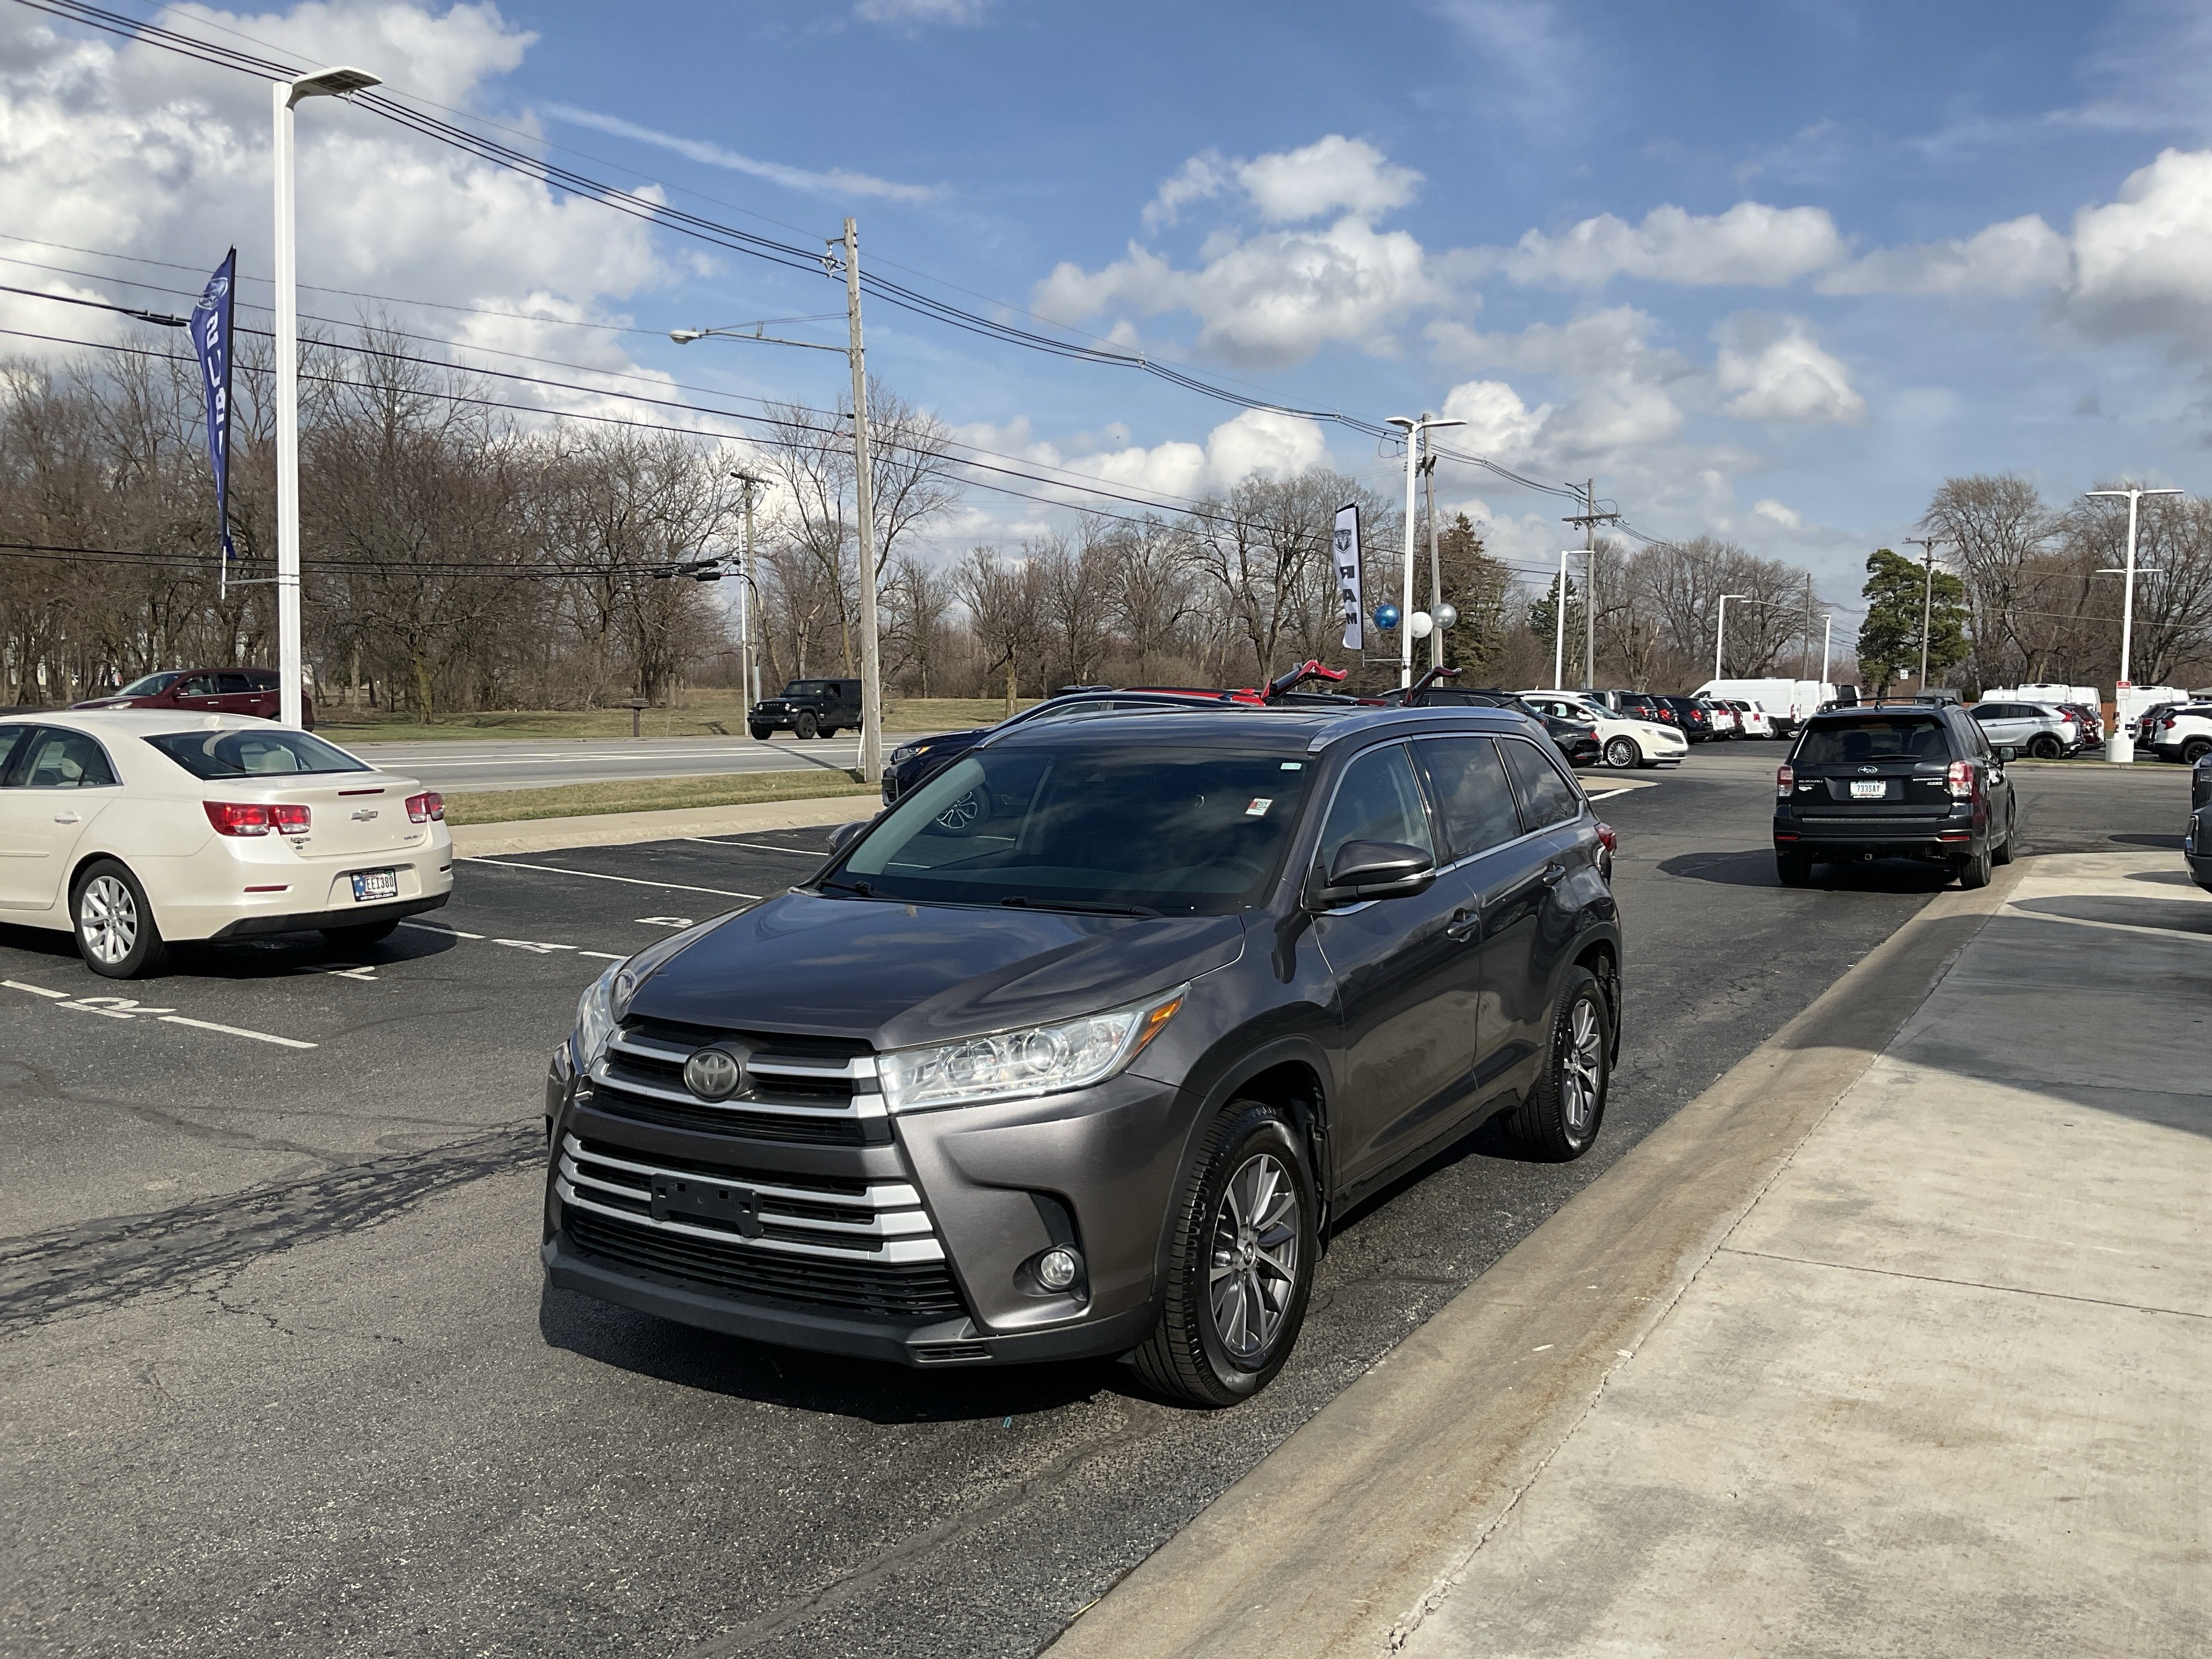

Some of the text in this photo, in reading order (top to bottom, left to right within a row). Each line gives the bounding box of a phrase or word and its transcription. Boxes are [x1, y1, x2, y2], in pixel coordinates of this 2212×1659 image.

[1857, 785, 1880, 793] 733SAY
[366, 876, 394, 890] EEI380
[55, 996, 178, 1019] R
